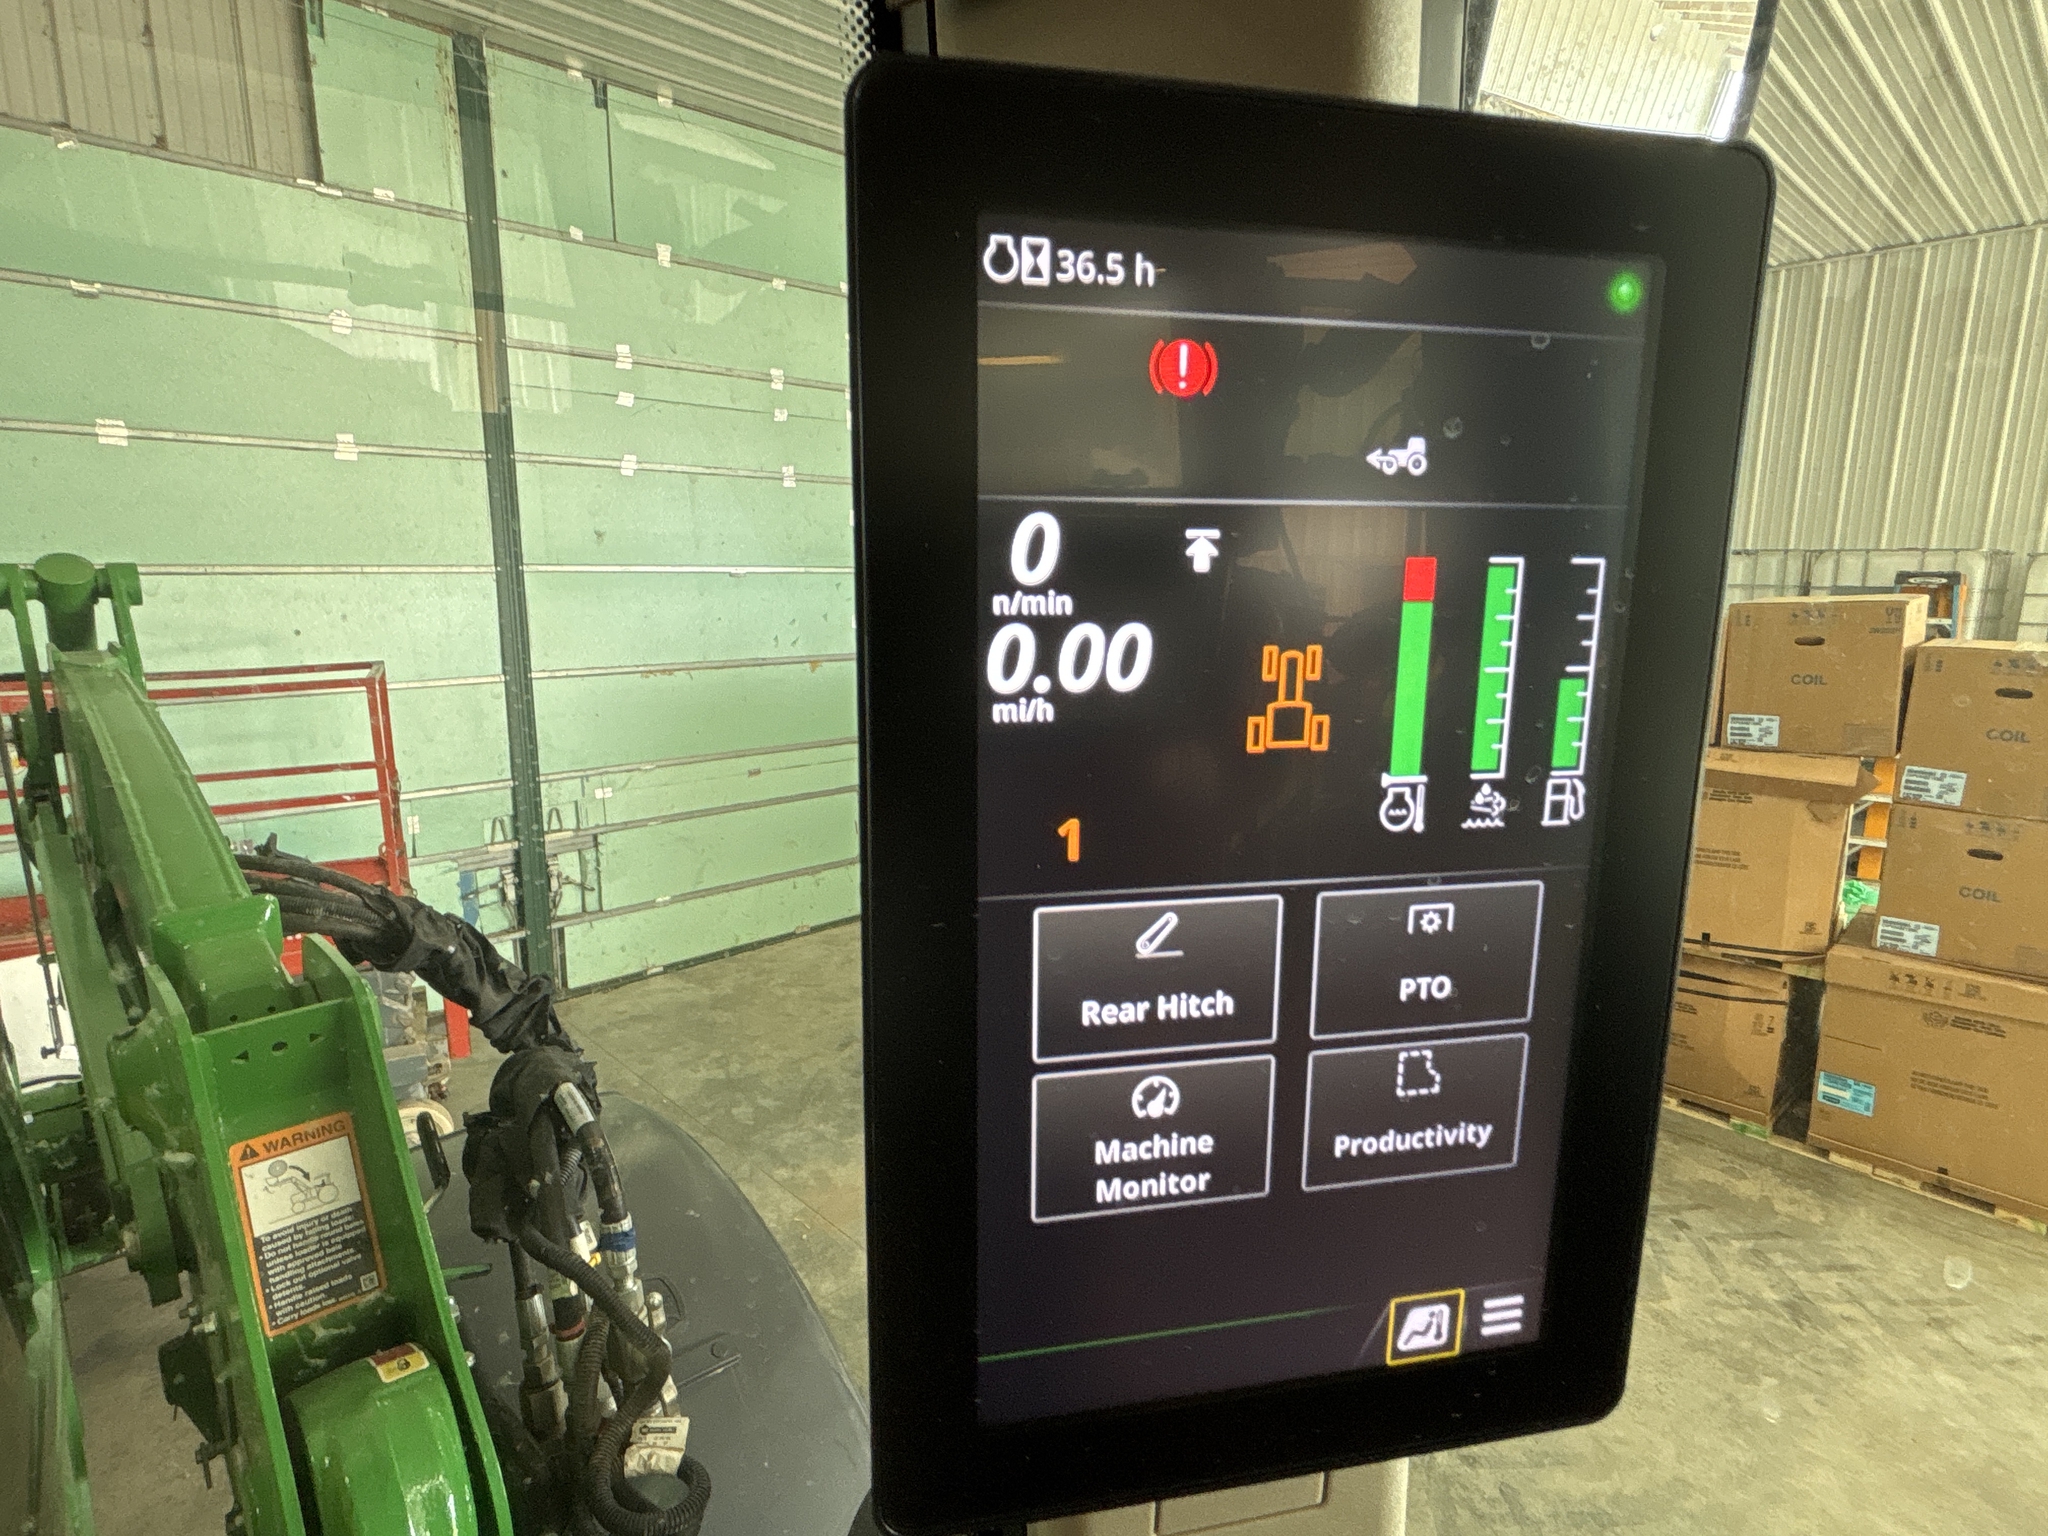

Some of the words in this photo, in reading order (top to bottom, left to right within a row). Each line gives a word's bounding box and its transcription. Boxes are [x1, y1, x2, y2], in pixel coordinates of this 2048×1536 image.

[1056, 249, 1125, 285] 36.5
[1136, 253, 1155, 287] h
[1011, 512, 1060, 586] 0
[993, 590, 1072, 615] n/min
[987, 622, 1152, 694] 0.00
[1791, 674, 1827, 685] COIL
[992, 697, 1054, 723] mi/h
[1986, 729, 2030, 743] COIL
[1058, 818, 1080, 862] 1
[1400, 976, 1452, 1001] PTO
[1082, 1000, 1150, 1026] Rear
[1158, 990, 1234, 1020] Hitch
[263, 1120, 346, 1153] WARNING
[1095, 1132, 1214, 1164] Machine
[1335, 1122, 1492, 1157] Productivity
[1096, 1172, 1210, 1204] Monitor
